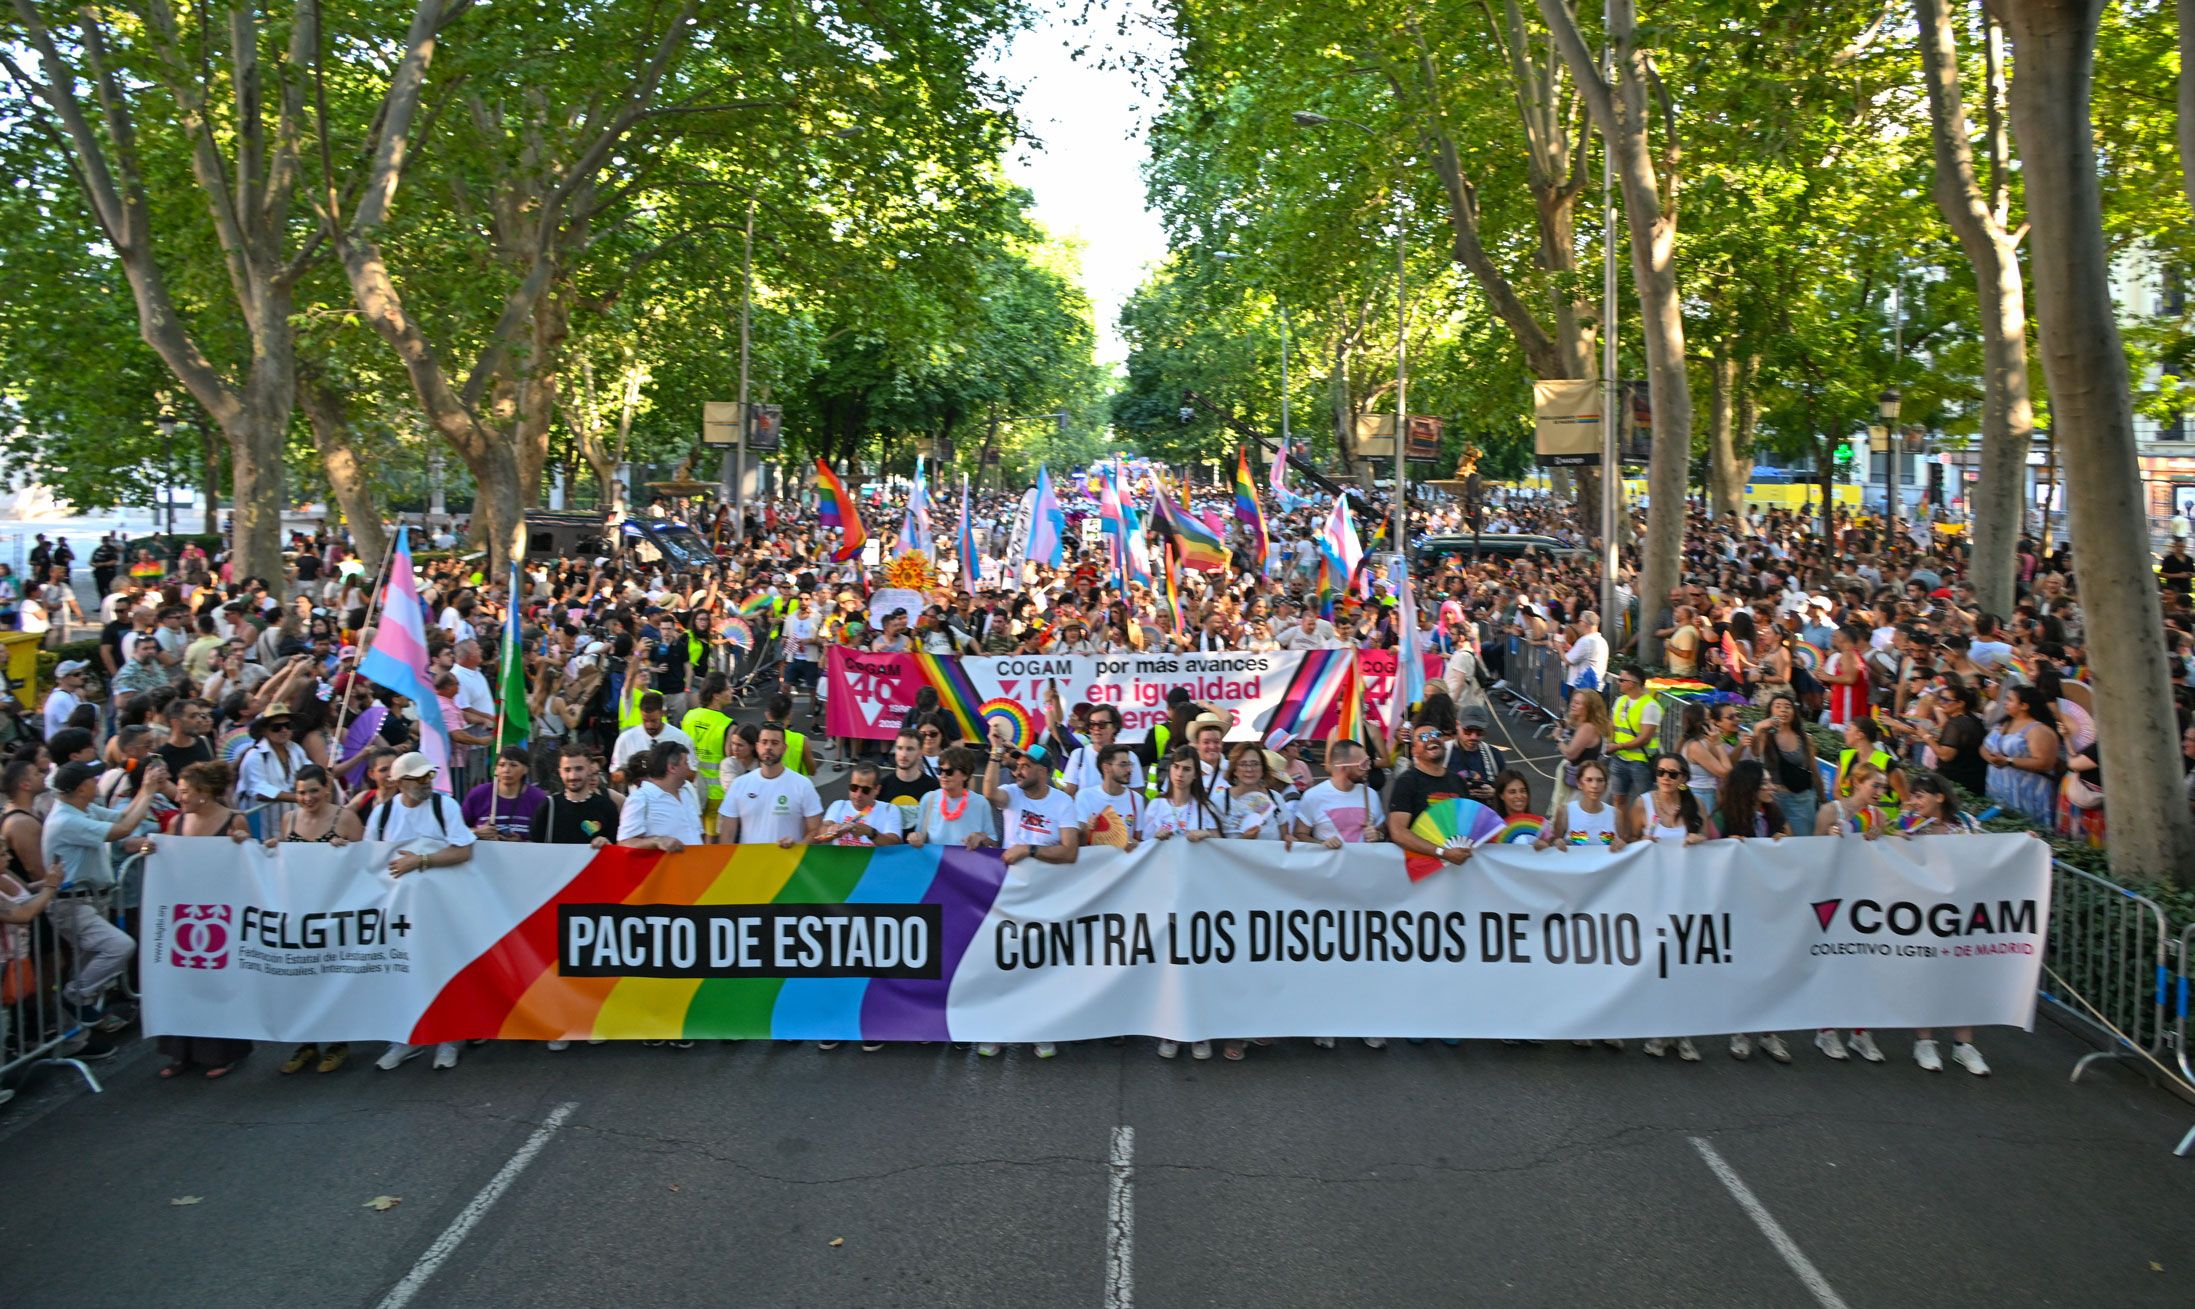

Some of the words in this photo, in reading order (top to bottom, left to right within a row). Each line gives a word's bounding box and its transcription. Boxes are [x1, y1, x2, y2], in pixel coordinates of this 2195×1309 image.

[844, 657, 901, 676] COGAM
[997, 660, 1072, 676] COGAM
[1095, 658, 1129, 678] por
[1136, 656, 1178, 673] más
[1186, 657, 1269, 673] avances
[1362, 661, 1396, 673] COG
[1086, 683, 1123, 703] en
[241, 905, 411, 950] FELGTBI+
[1849, 899, 2038, 938] COGAM
[568, 915, 697, 969] PACTO
[709, 917, 762, 968] DE
[774, 915, 928, 969] ESTADO
[995, 913, 1157, 971] CONTRA
[1168, 910, 1236, 965] LOS
[1249, 909, 1467, 964] DISCURSOS
[1479, 911, 1532, 964] DE
[1543, 912, 1641, 967] ODIO
[1656, 912, 1733, 979] ¡YA!
[1809, 943, 1891, 956] COLECTIVO
[1954, 945, 1972, 957] DE
[1975, 942, 2034, 955] MADRID
